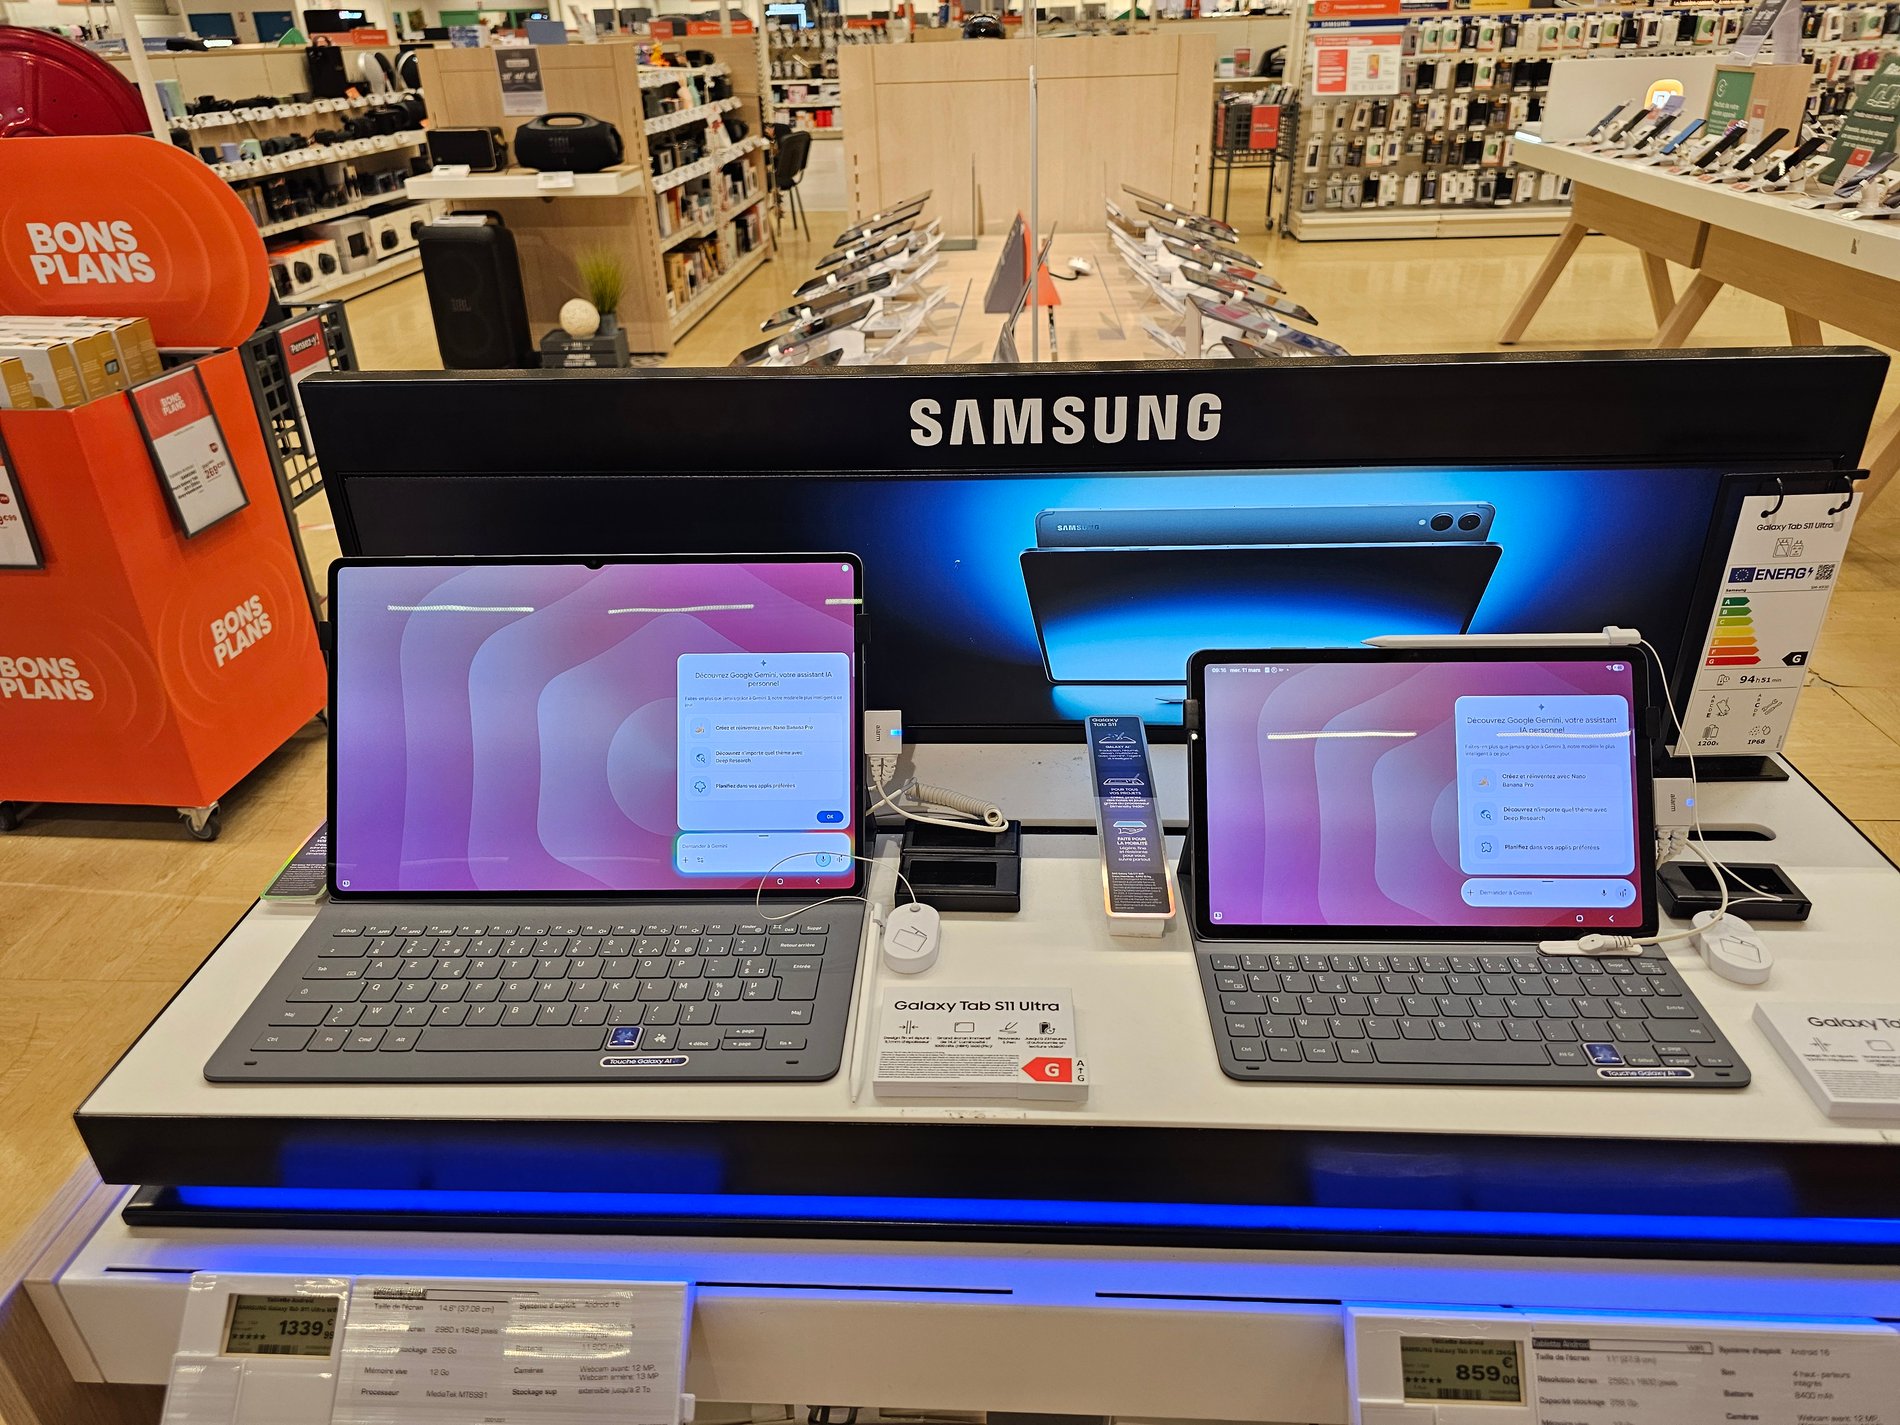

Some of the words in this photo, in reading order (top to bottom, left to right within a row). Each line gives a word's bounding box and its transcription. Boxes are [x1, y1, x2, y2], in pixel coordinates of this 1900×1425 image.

[26, 220, 138, 254] BONS
[29, 251, 156, 285] PLANS
[162, 399, 186, 417] PLANS
[910, 392, 1222, 447] SAMSUNG
[1056, 524, 1100, 532] SAMSUNG
[1756, 523, 1787, 532] Galaxy
[1803, 522, 1814, 530] S11
[1814, 521, 1834, 529] Ultra
[1755, 567, 1806, 581] ENERG
[210, 594, 264, 645] BONS
[213, 613, 273, 668] PLANS
[1792, 653, 1802, 664] G
[0, 655, 81, 681] BONS
[695, 671, 729, 679] Découvrez
[730, 672, 753, 681] Google
[754, 671, 778, 680] Gemini,
[0, 678, 94, 701] PLANS
[748, 680, 780, 688] personnel
[1467, 716, 1506, 724] Découvrez
[1507, 716, 1534, 726] Google
[1535, 716, 1563, 725] Gemini,
[1585, 716, 1617, 724] assistant
[1528, 727, 1565, 735] personnel
[894, 1000, 957, 1014] Galaxy
[959, 1000, 991, 1011] Tab
[995, 1000, 1015, 1011] S11
[1019, 1000, 1060, 1012] Ultra
[1807, 1016, 1878, 1031] Galaxy
[637, 1058, 664, 1067] Galaxy
[665, 1057, 673, 1065] AI
[1044, 1062, 1060, 1078] G
[1638, 1070, 1667, 1078] Galaxy
[481, 1306, 495, 1314] cm)
[279, 1319, 324, 1336] 1339
[1502, 1356, 1513, 1369] €
[364, 1367, 394, 1375] Mémoire
[430, 1368, 439, 1376] 12
[440, 1368, 450, 1376] Go
[513, 1366, 544, 1374] Caméras
[580, 1365, 610, 1373] Webcam
[1456, 1364, 1501, 1381] 859
[578, 1373, 609, 1382] Webcam
[646, 1372, 659, 1380] MP
[512, 1388, 543, 1396] Stockage
[544, 1388, 557, 1397] sup
